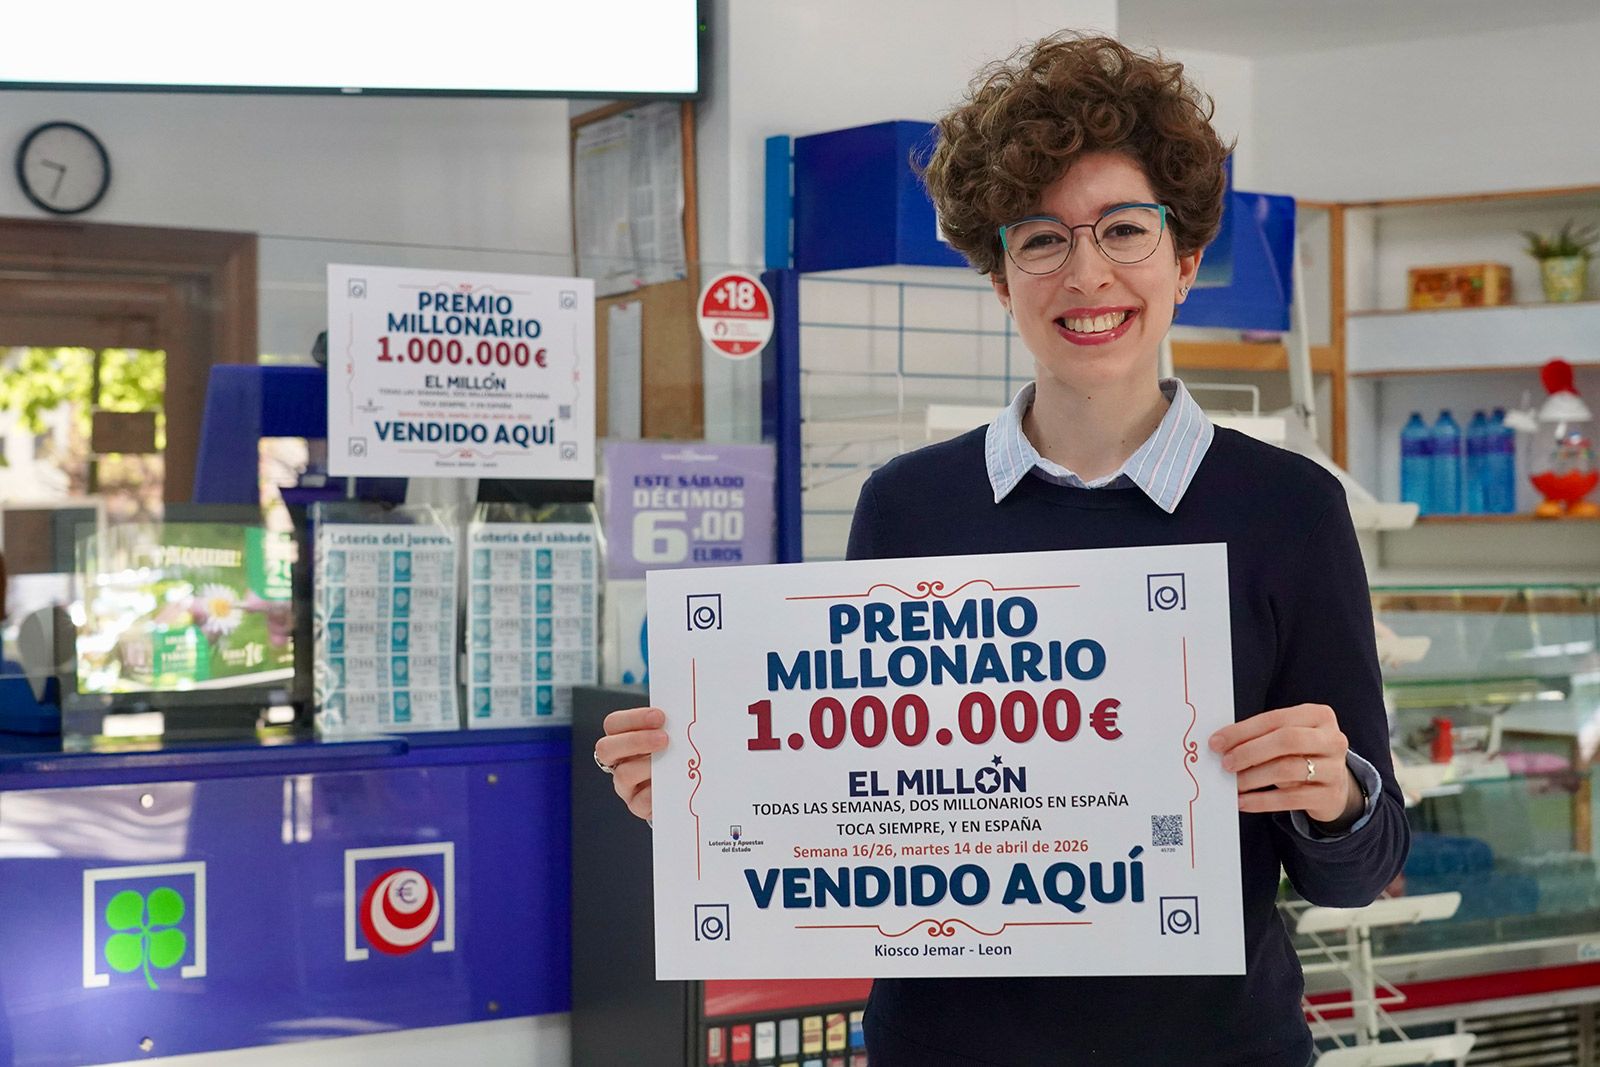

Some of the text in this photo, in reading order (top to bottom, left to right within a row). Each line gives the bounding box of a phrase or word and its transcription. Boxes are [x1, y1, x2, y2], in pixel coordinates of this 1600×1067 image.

[418, 291, 513, 315] PREMIO
[713, 281, 756, 310] +18
[387, 312, 541, 339] MILLONARIO
[377, 337, 547, 368] 1.000.000€
[425, 375, 444, 388] EL
[375, 418, 555, 448] VENDIDO AQUÍ
[634, 474, 744, 488] ESTE SÁBADO
[632, 487, 744, 508] DÉCIMOS
[382, 532, 404, 545] del
[522, 531, 543, 543] del
[693, 547, 742, 562] EUROS
[829, 596, 1038, 645] PREMIO
[767, 638, 1106, 692] MILLONARIO
[747, 688, 1123, 752] 1.000.000€
[849, 770, 889, 797] EL
[752, 791, 1129, 815] TODAS LAS SEMANAS, DOS MILLONARIOS EN ESPAÑA
[836, 816, 1042, 836] TOCA SIEMPRE, Y EN ESPAÑA
[793, 840, 1089, 859] Semana 16/26, martes 14 de abril de 2026
[743, 845, 1145, 914] VENDIDO AQUÍ
[874, 943, 919, 957] Kiosco
[922, 943, 966, 956] Jemar
[978, 942, 1012, 955] Leon
